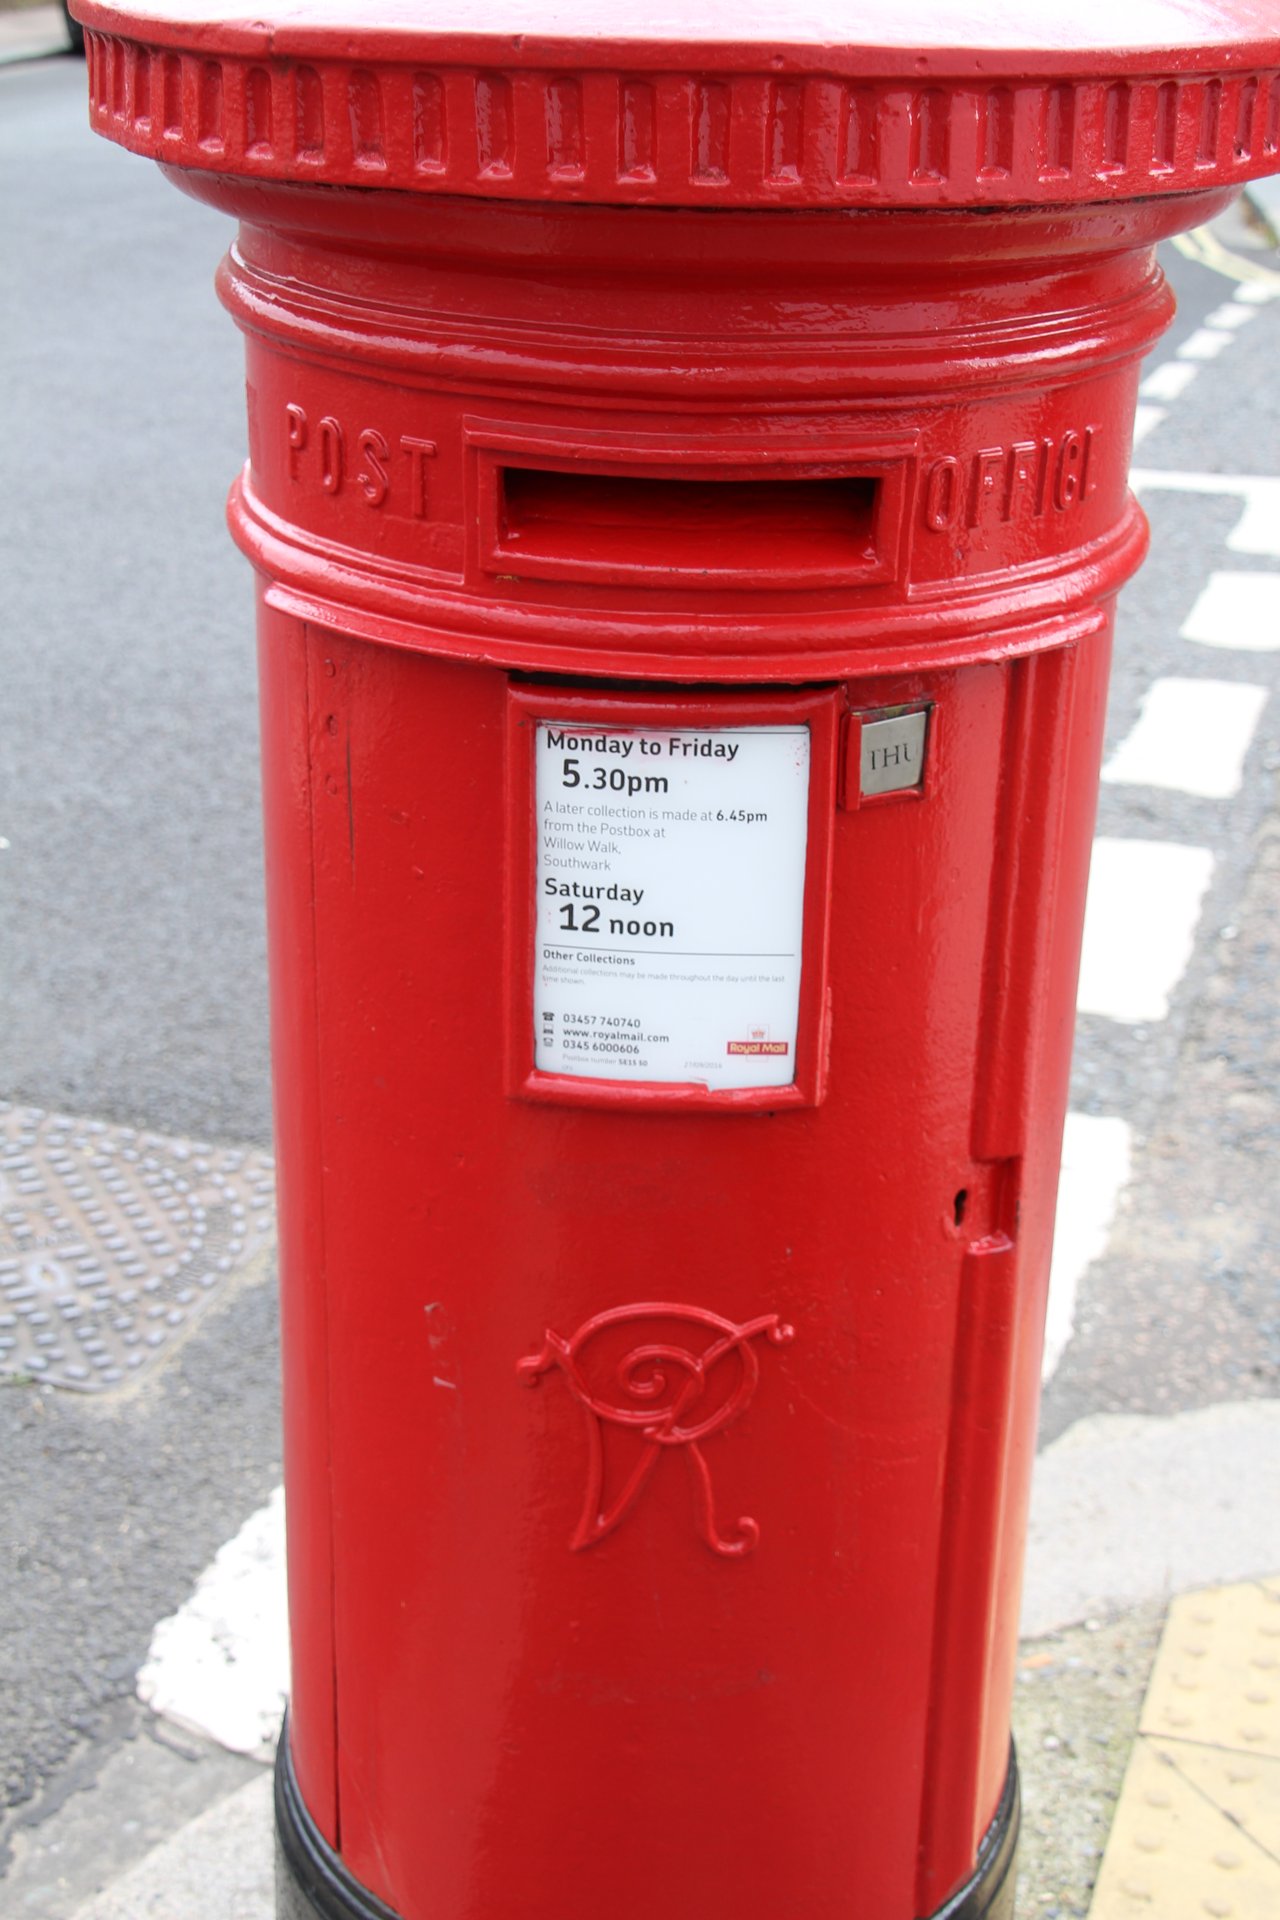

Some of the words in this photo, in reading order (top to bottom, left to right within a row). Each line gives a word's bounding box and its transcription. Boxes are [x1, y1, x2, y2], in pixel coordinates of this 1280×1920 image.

[286, 402, 437, 518] POST
[927, 424, 1103, 532] OFFICE
[547, 730, 634, 758] Monday
[640, 737, 662, 757] to
[669, 738, 740, 762] Friday
[867, 742, 912, 771] THU
[562, 758, 669, 797] 5.30pm
[544, 800, 553, 812] A
[556, 801, 584, 816] later
[587, 804, 646, 820] collection
[649, 806, 659, 820] is
[662, 808, 697, 822] made
[700, 809, 713, 822] at
[716, 809, 768, 825] 6.45pm
[544, 818, 574, 834] from
[577, 820, 597, 835] the
[600, 822, 650, 838] Postbox
[653, 825, 666, 839] at
[544, 836, 585, 852] Willow
[587, 838, 622, 855] Walk,
[544, 854, 611, 872] Southwark
[545, 877, 644, 906] Saturday
[559, 903, 601, 933] 12
[609, 917, 674, 938] noon
[543, 949, 574, 962] Other
[576, 952, 636, 966] Collections
[563, 1013, 597, 1025] 03457
[599, 1016, 641, 1029] 740740
[563, 1027, 670, 1043] www.royalmail.com
[562, 1038, 590, 1051] 0345
[592, 1041, 640, 1055] 6000606
[730, 1043, 760, 1054] Royal
[762, 1043, 785, 1053] Mail
